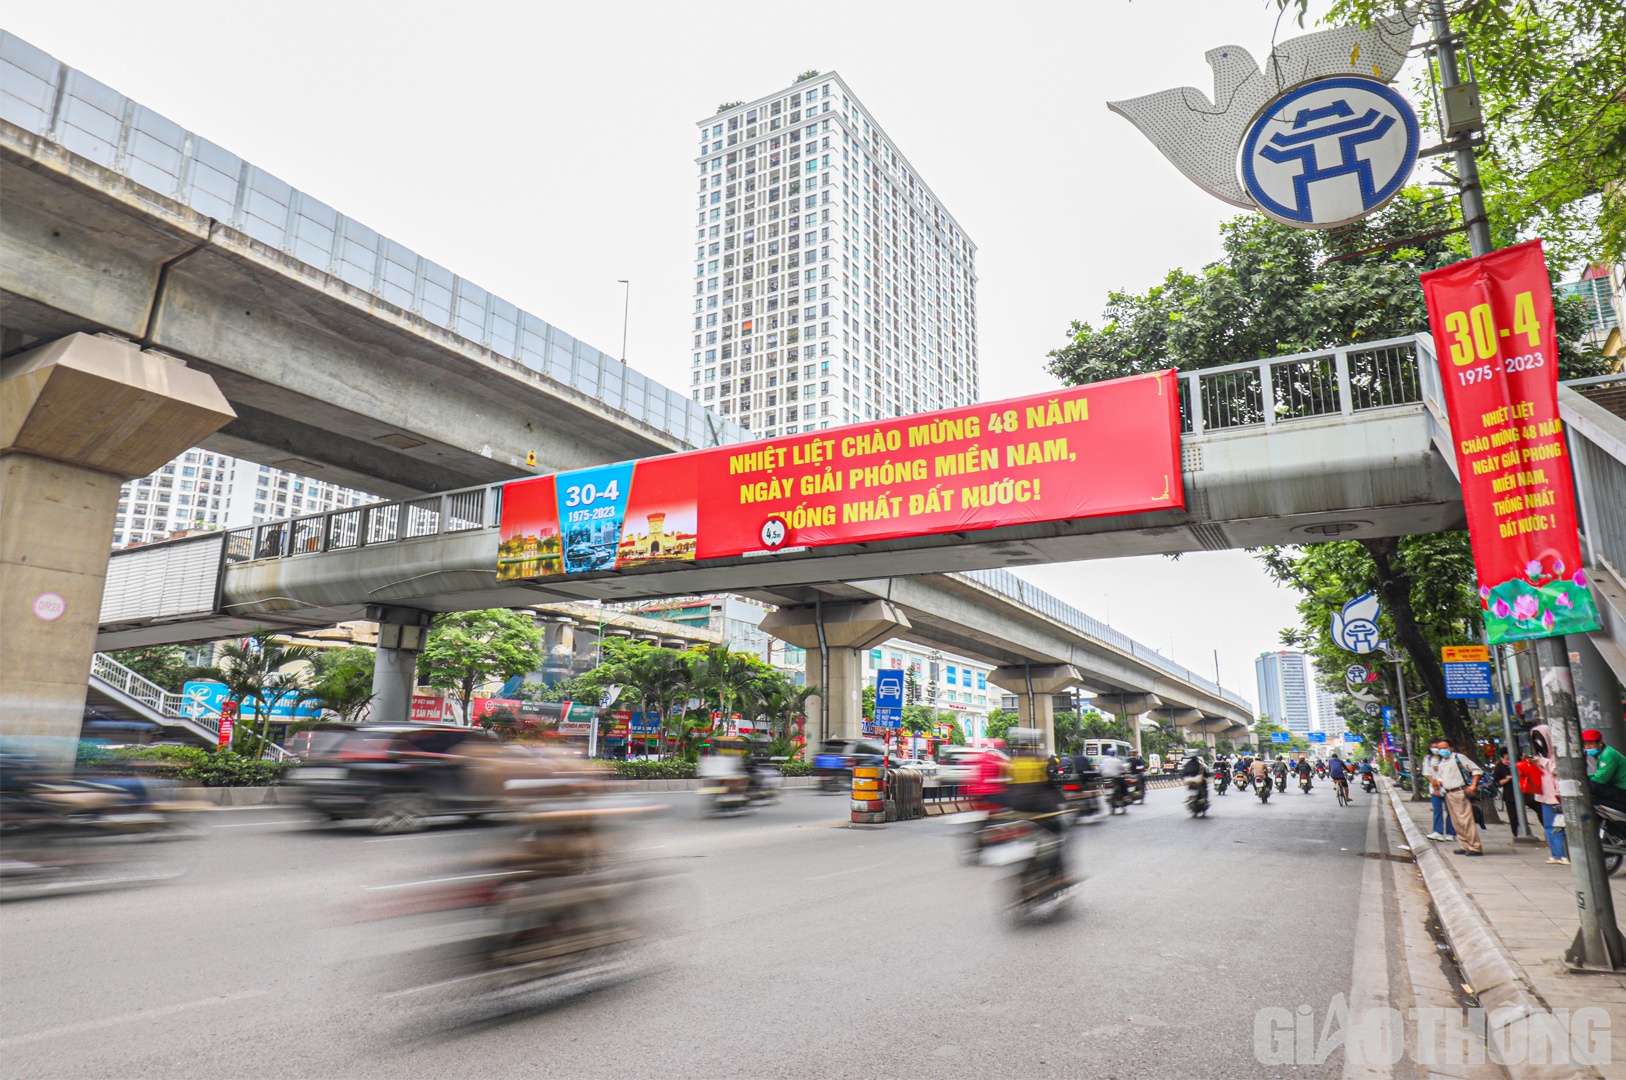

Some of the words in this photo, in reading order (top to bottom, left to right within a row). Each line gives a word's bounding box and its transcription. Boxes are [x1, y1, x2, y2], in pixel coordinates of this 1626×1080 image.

[1458, 365, 1493, 386] 1975
[1505, 352, 1544, 373] 2023
[1482, 406, 1509, 428] NHIỆT
[1510, 401, 1535, 421] LIỆT
[730, 445, 787, 475] NHIỆT
[793, 438, 835, 467] LIỆT
[842, 428, 901, 458] CHÀO
[908, 416, 980, 448] MỪNG
[988, 410, 1018, 434] 48
[1026, 397, 1089, 430] NĂM
[1461, 435, 1491, 455] CHÀO
[1491, 428, 1520, 448] MỪNG
[1522, 424, 1537, 440] 48
[740, 476, 794, 505] NGÀY
[800, 466, 842, 496] GIẢI
[849, 459, 927, 490] PHÓNG
[935, 444, 999, 478] MIỀN
[1006, 437, 1077, 468] NAM,
[1472, 455, 1500, 475] NGÀY
[1501, 446, 1520, 468] GIẢI
[1522, 442, 1562, 463] PHÓNG
[565, 479, 620, 508] 30-4
[1492, 472, 1517, 494] MIỀN
[1517, 469, 1549, 487] NAM,
[568, 505, 615, 523] 1975-2023
[842, 490, 903, 524] NHẤT
[909, 483, 955, 517] ĐẤT
[961, 477, 1041, 510] NƯỚC!
[1493, 494, 1524, 516] THỐNG
[1524, 487, 1556, 509] NHẤT
[1499, 516, 1518, 539] ĐẤT
[38, 601, 62, 613] DR28
